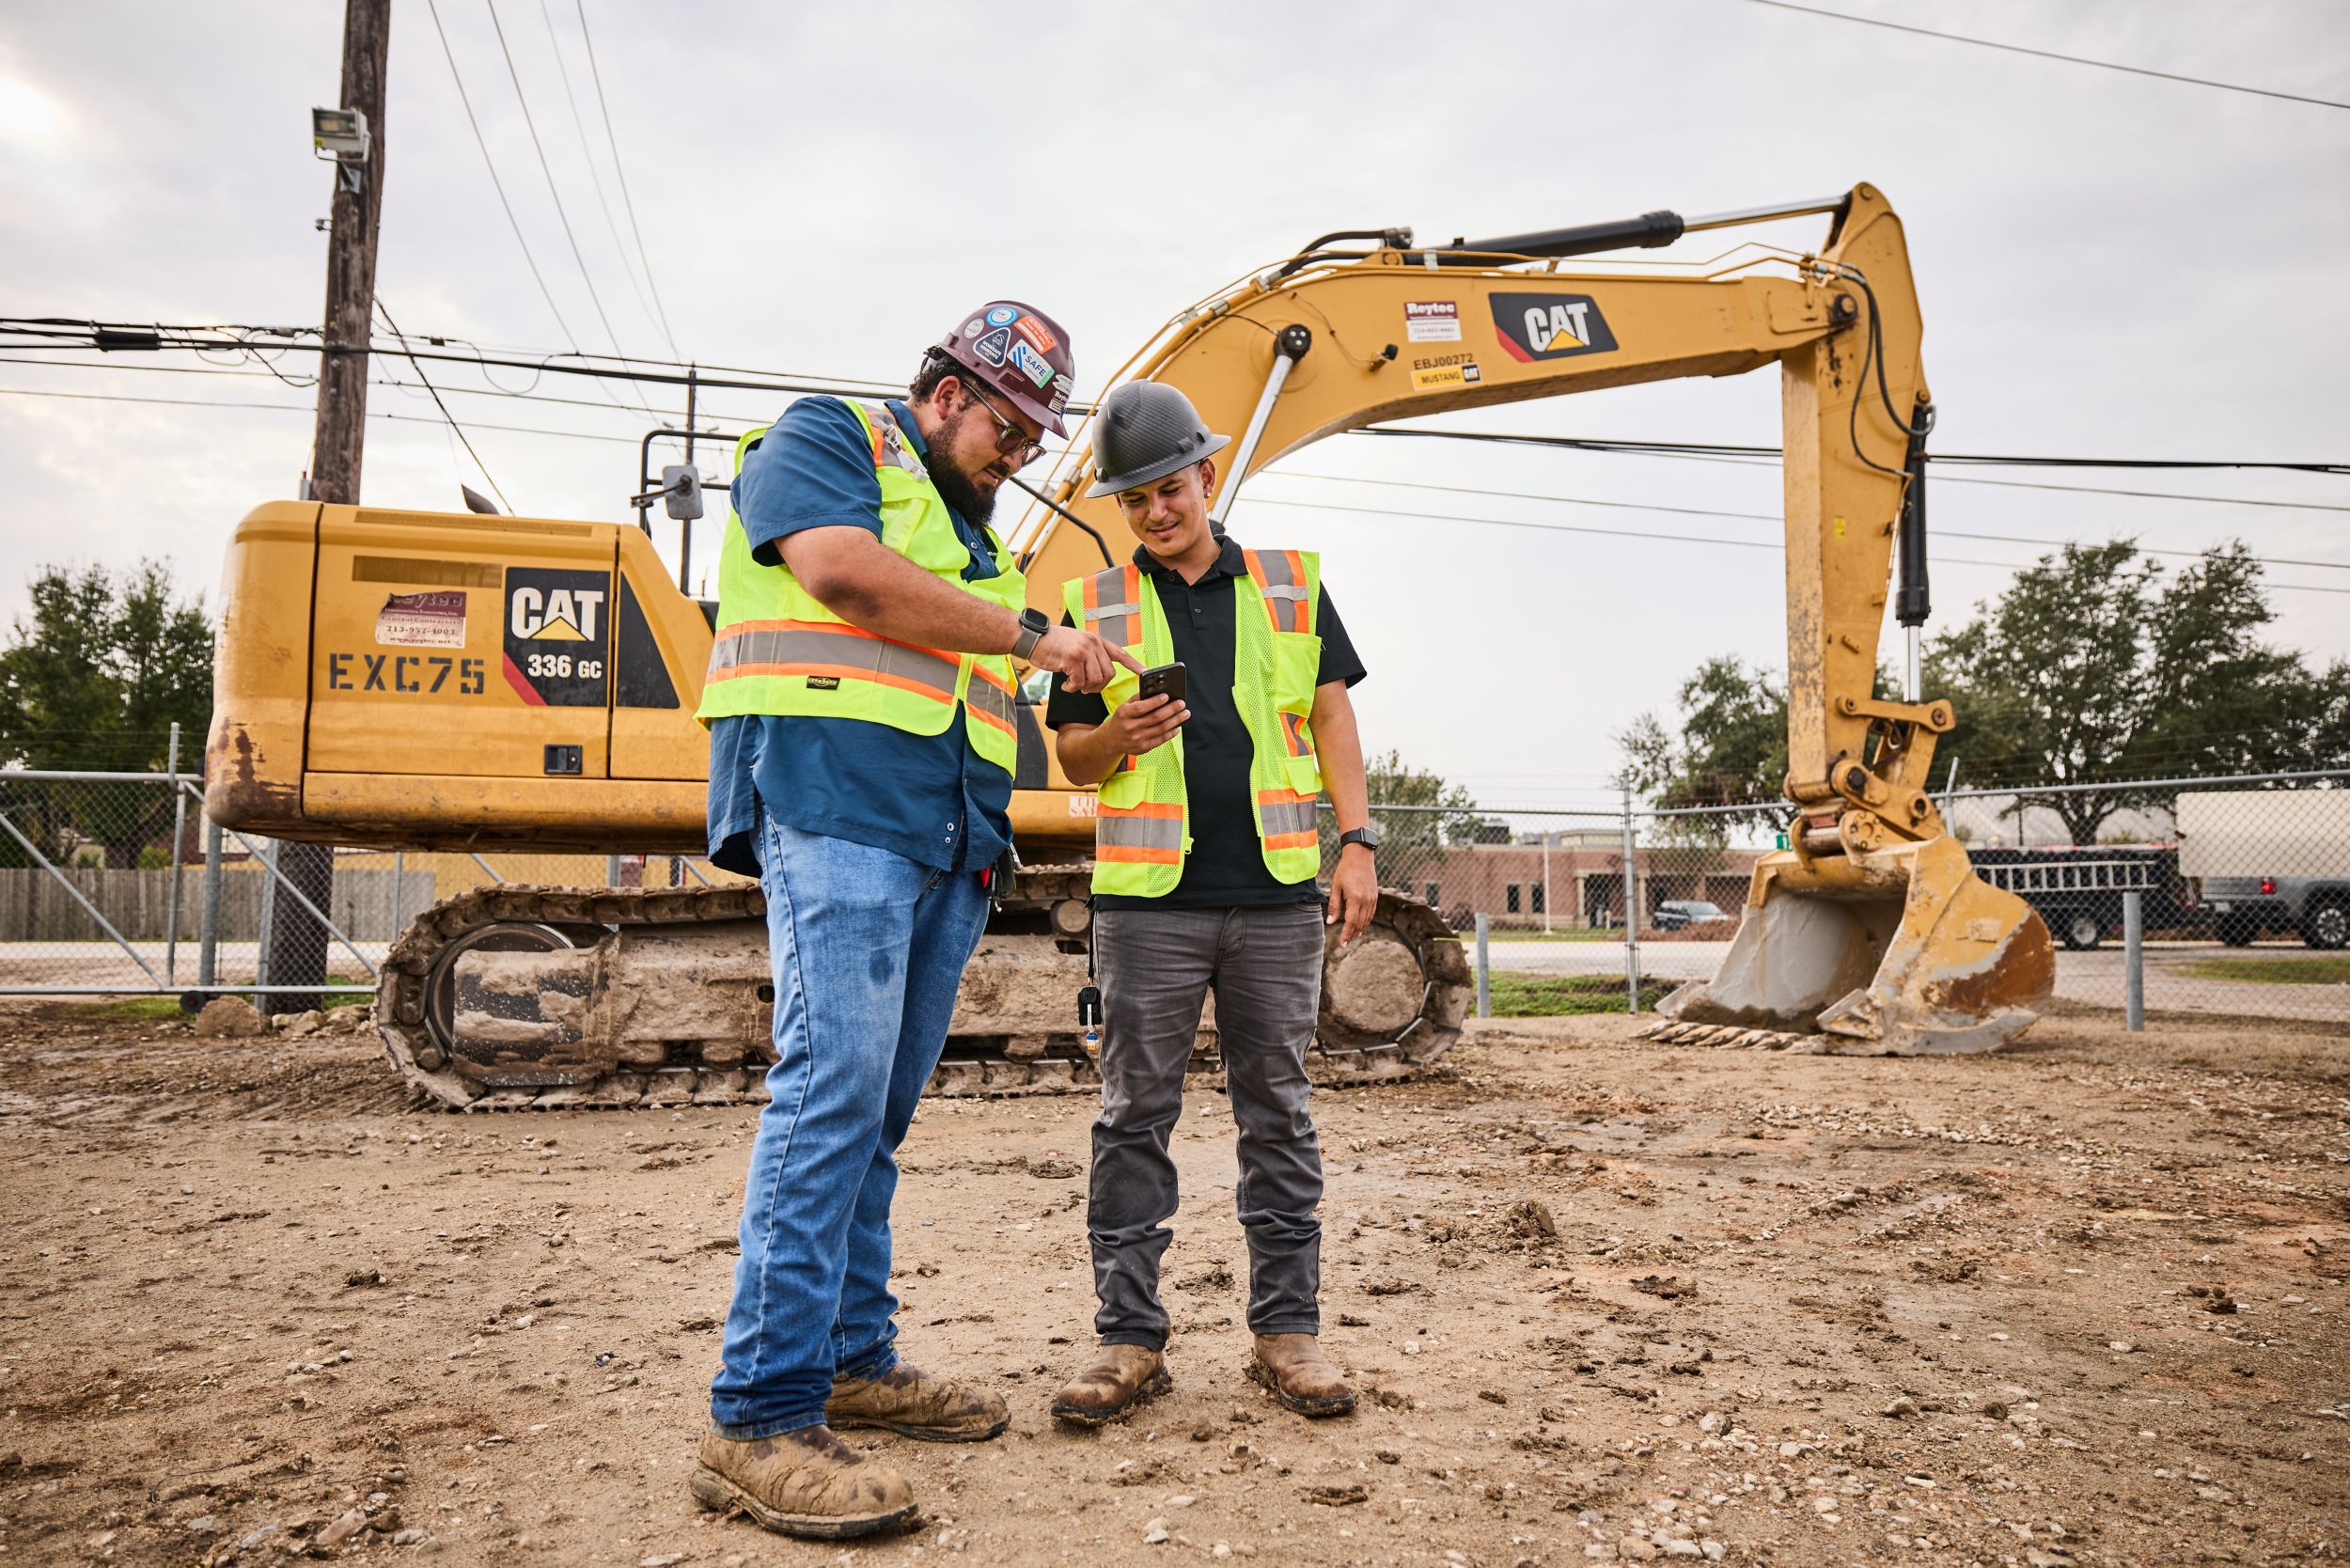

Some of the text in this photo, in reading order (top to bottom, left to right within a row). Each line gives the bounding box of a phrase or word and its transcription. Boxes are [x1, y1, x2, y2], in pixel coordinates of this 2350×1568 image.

[1524, 303, 1590, 353] CAT
[1025, 355, 1046, 377] SAFE
[1414, 353, 1475, 370] EBJ00272
[1421, 371, 1461, 384] MUSTANG
[511, 587, 604, 641] CAT
[330, 653, 484, 694] EXC75
[527, 653, 603, 679] 336 GC
